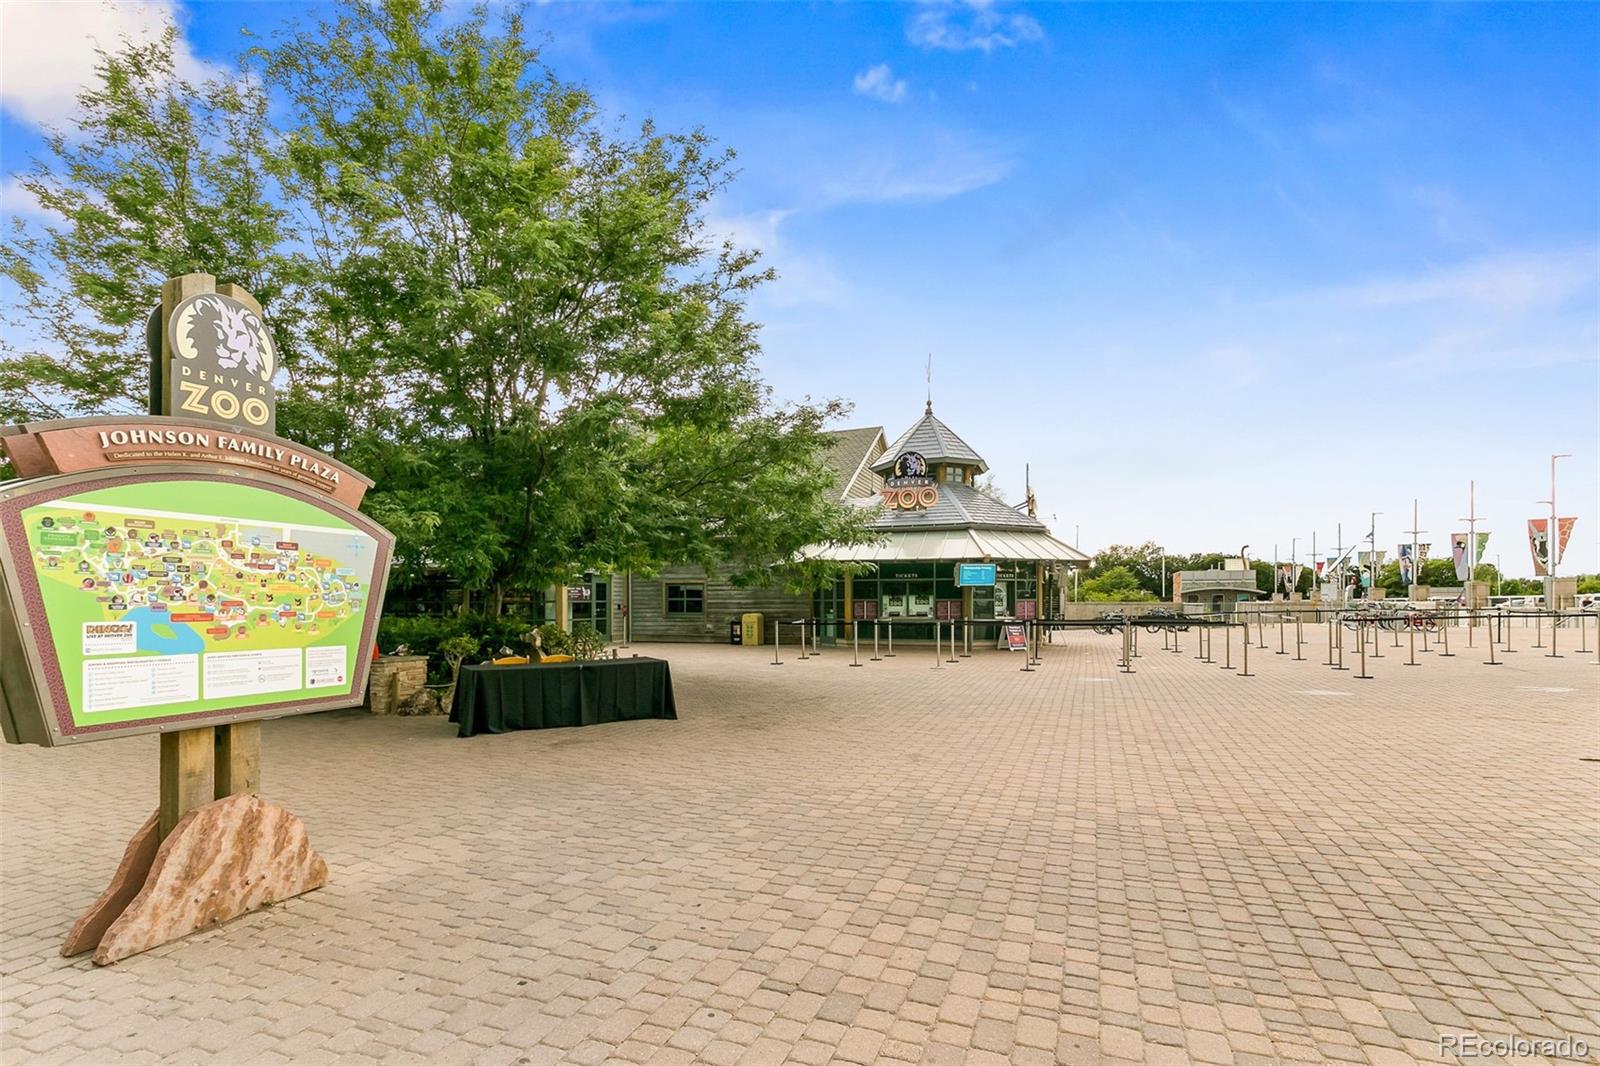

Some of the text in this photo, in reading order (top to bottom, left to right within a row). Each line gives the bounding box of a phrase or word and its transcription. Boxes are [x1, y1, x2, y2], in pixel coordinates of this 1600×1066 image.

[182, 366, 267, 396] DENVER
[180, 380, 270, 426] ZOO
[98, 430, 340, 484] JOHNSON FAMILY PLAZA
[114, 451, 145, 459] Dedicated
[890, 479, 929, 487] DENVER
[880, 486, 939, 509] ZOO
